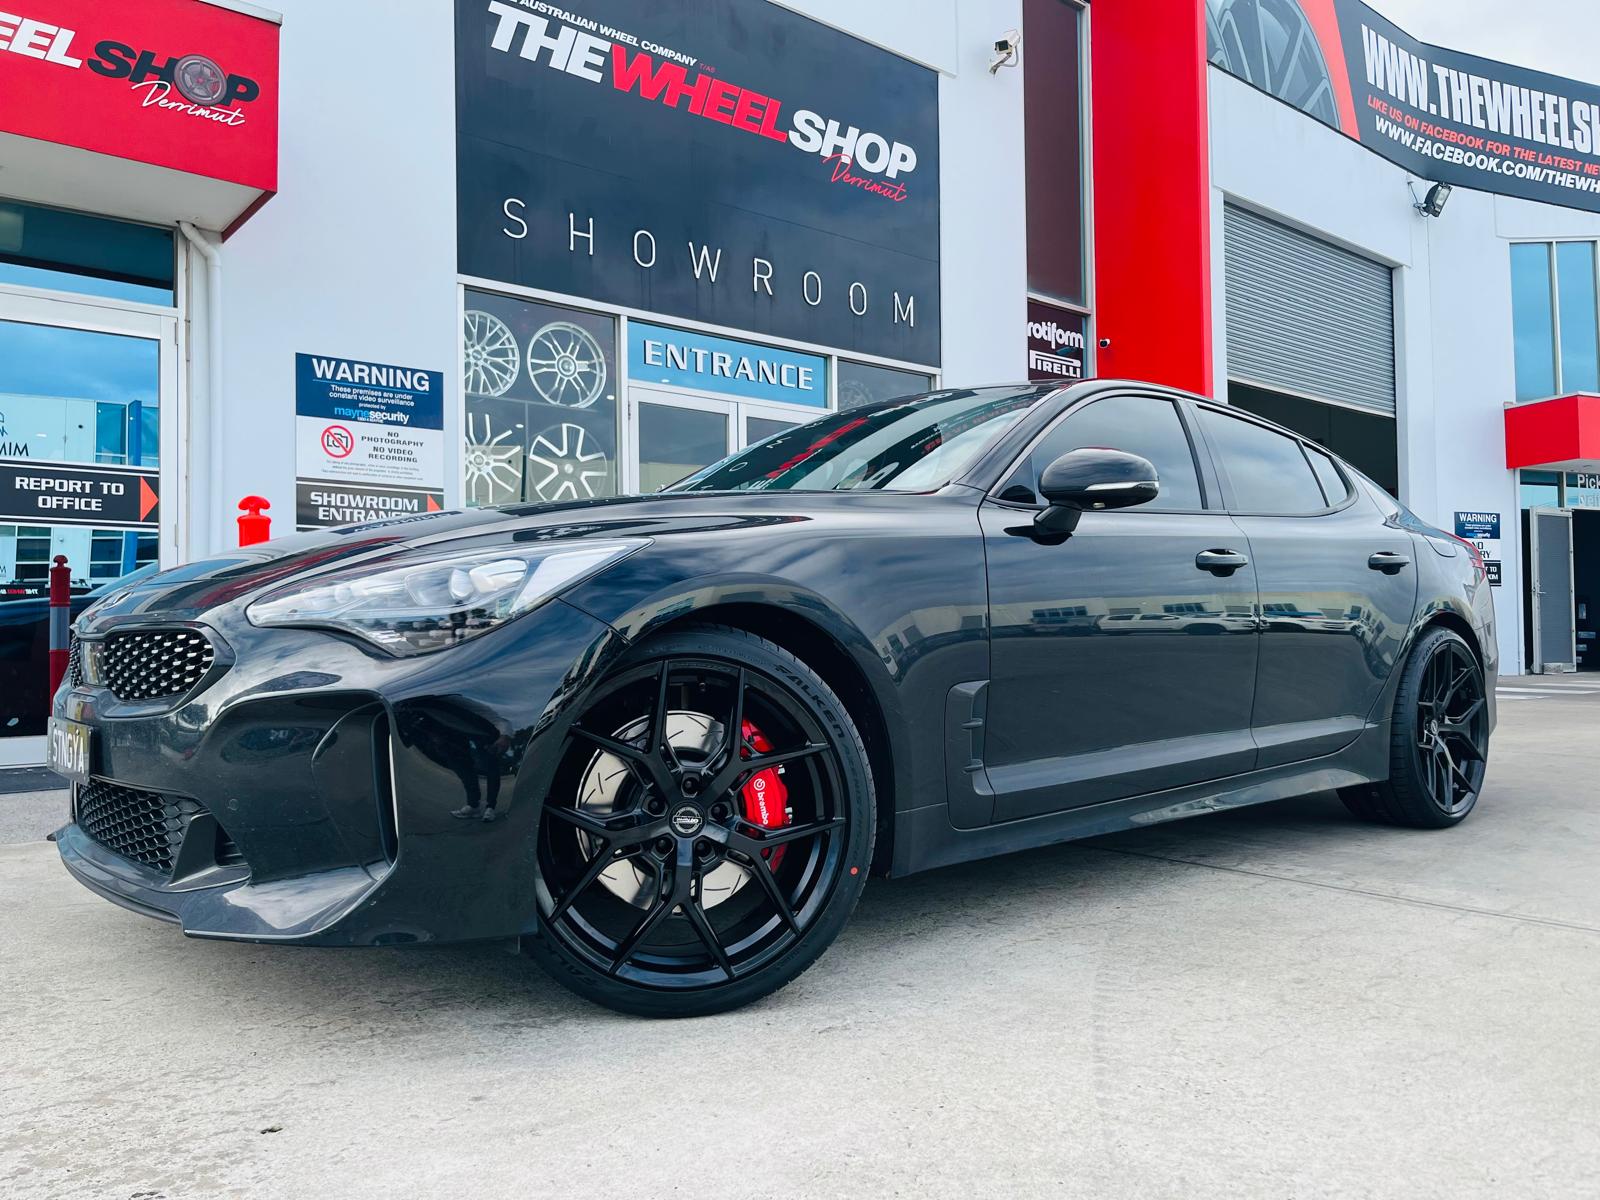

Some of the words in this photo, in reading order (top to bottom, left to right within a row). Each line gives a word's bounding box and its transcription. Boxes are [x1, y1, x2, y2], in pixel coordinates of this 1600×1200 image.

[519, 0, 598, 32] AUSTRALIAN
[599, 24, 639, 47] WHEEL
[641, 40, 698, 67] COMPANY
[87, 40, 260, 107] SHOP
[131, 80, 245, 127] Derrimut
[787, 109, 917, 179] SHOP
[1367, 94, 1388, 115] LIKE
[1389, 105, 1402, 122] US
[1404, 114, 1419, 131] ON
[1420, 121, 1484, 150] FACEBOOK
[1485, 140, 1511, 157] FOR
[1513, 147, 1536, 162] THE
[1538, 153, 1582, 172] LATEST
[1375, 115, 1600, 194] WWW.FACEBOOK.COM/THEWH
[822, 153, 908, 202] Derrimut
[502, 198, 915, 328] SHOWROOM
[1027, 321, 1084, 349] rotiform
[311, 358, 430, 392] WARNING
[643, 339, 814, 391] ENTRANCE
[1029, 349, 1081, 378] PIRELLI
[329, 391, 358, 401] constant
[377, 397, 415, 407] surveillance
[330, 384, 351, 393] These
[352, 387, 382, 398] premises
[361, 435, 424, 447] PHOTOGRAPHY
[368, 453, 418, 463] RECORDING
[388, 448, 413, 456] VIDEO
[15, 476, 93, 494] REPORT
[99, 481, 124, 496] TO
[37, 495, 102, 511] OFFICE
[310, 491, 419, 511] SHOWROOM
[318, 506, 411, 522] ENTRAN
[1459, 513, 1497, 523] WARNING
[774, 664, 846, 738] FALKEN
[52, 728, 85, 774] STNGYA
[757, 791, 768, 825] brembo
